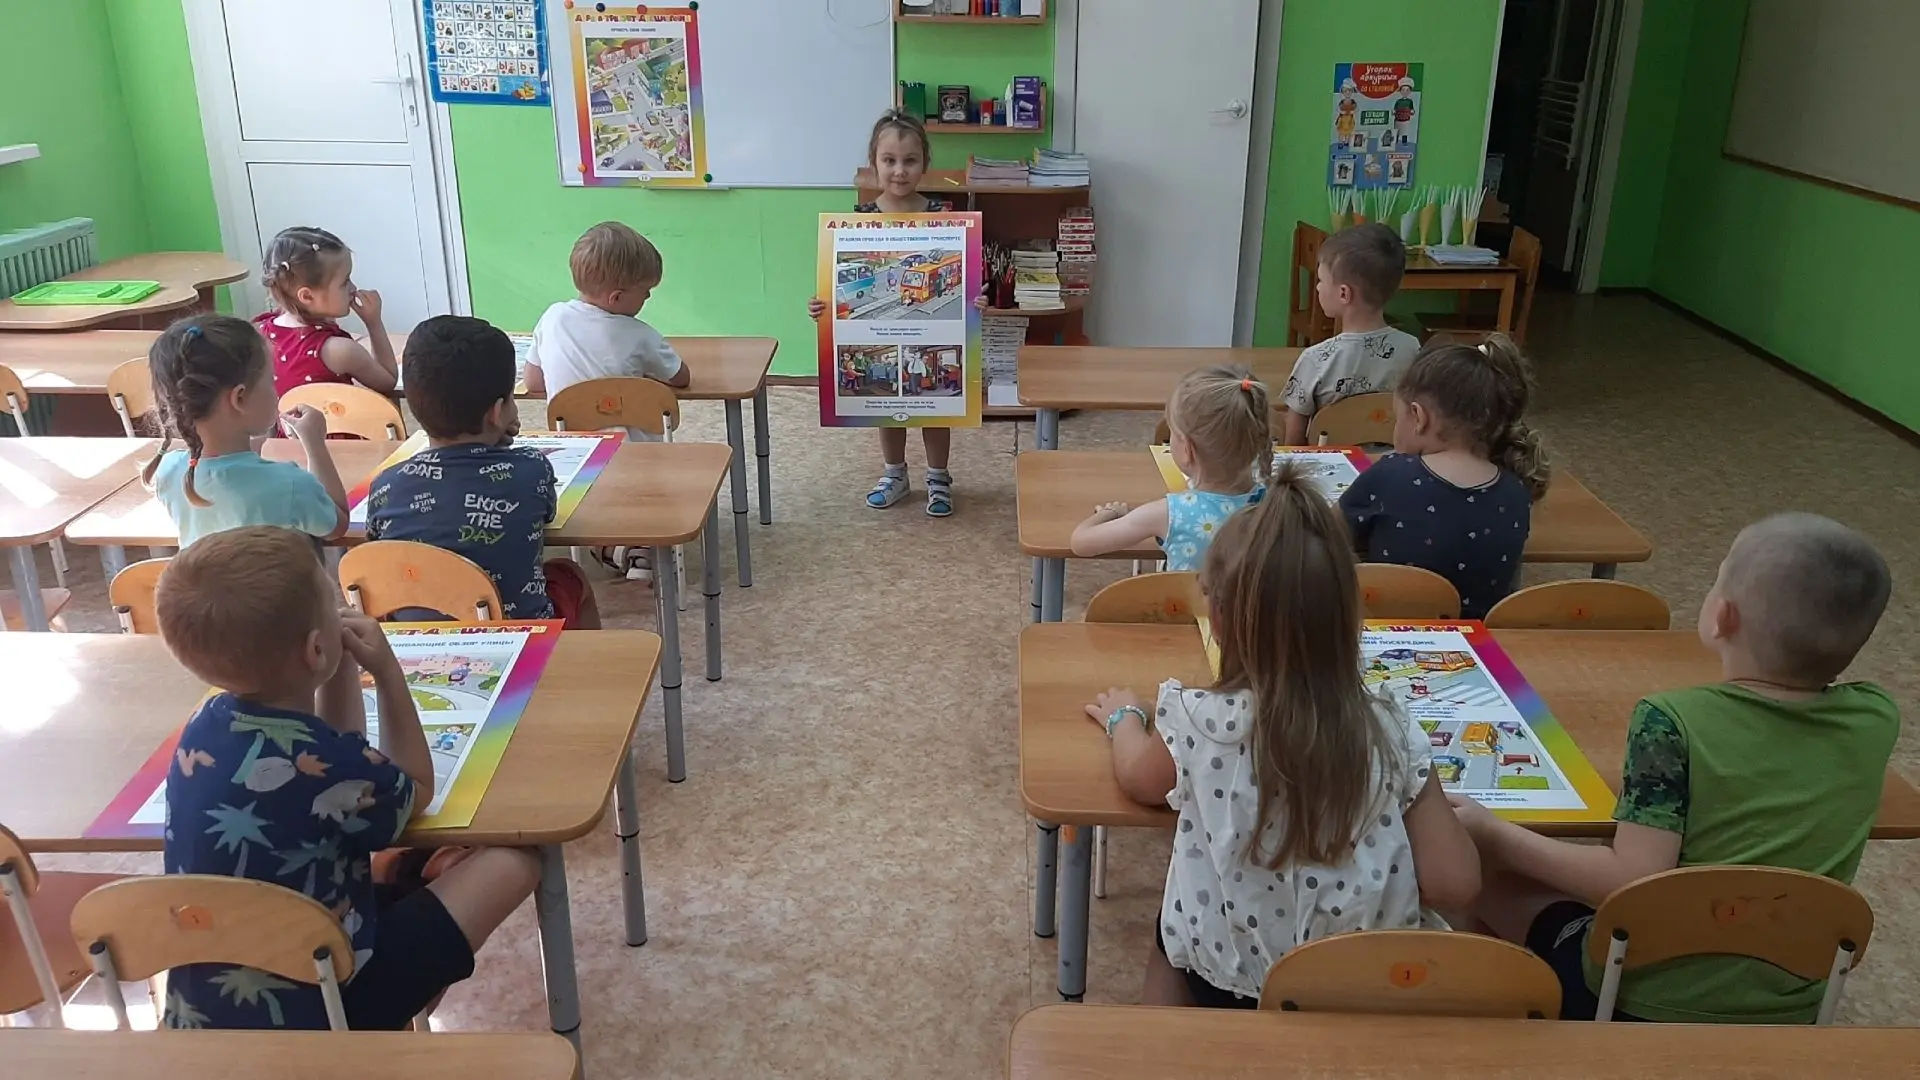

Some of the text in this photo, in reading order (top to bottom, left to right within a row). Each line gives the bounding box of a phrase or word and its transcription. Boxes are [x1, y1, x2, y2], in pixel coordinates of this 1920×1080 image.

[479, 462, 514, 475] EXTRA
[489, 472, 513, 483] FUN
[464, 493, 520, 514] ENJOY
[466, 512, 504, 529] THE
[457, 525, 506, 545] DAY
